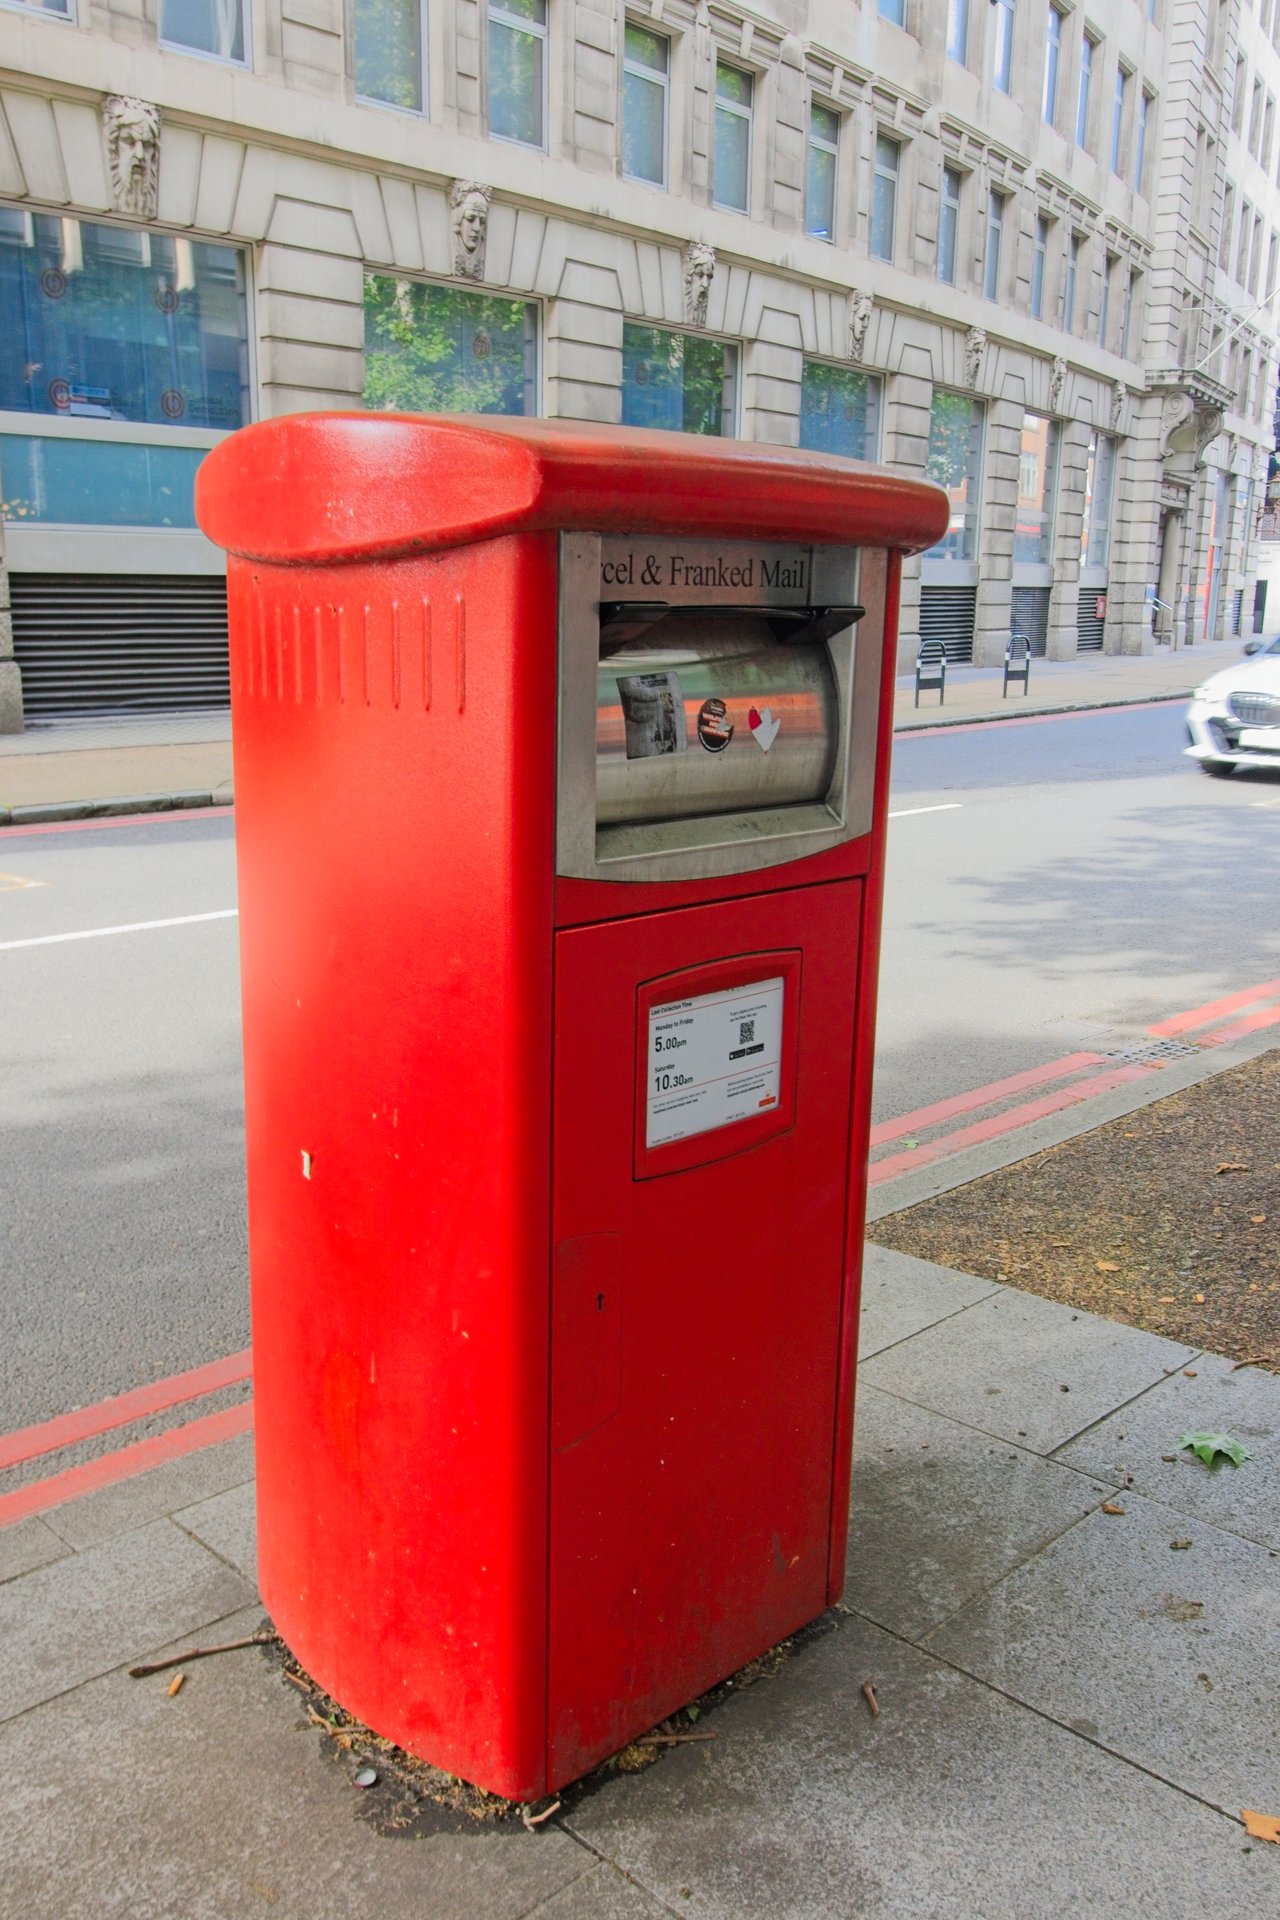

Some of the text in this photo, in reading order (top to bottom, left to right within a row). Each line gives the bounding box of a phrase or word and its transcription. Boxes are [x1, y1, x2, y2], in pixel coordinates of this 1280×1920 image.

[600, 554, 804, 588] cel & Franked Mail
[661, 1004, 681, 1013] Collection
[656, 1023, 673, 1031] Monday
[655, 1036, 687, 1052] 5.00pm
[655, 1063, 675, 1073] Saturday
[655, 1074, 693, 1092] 10.30am
